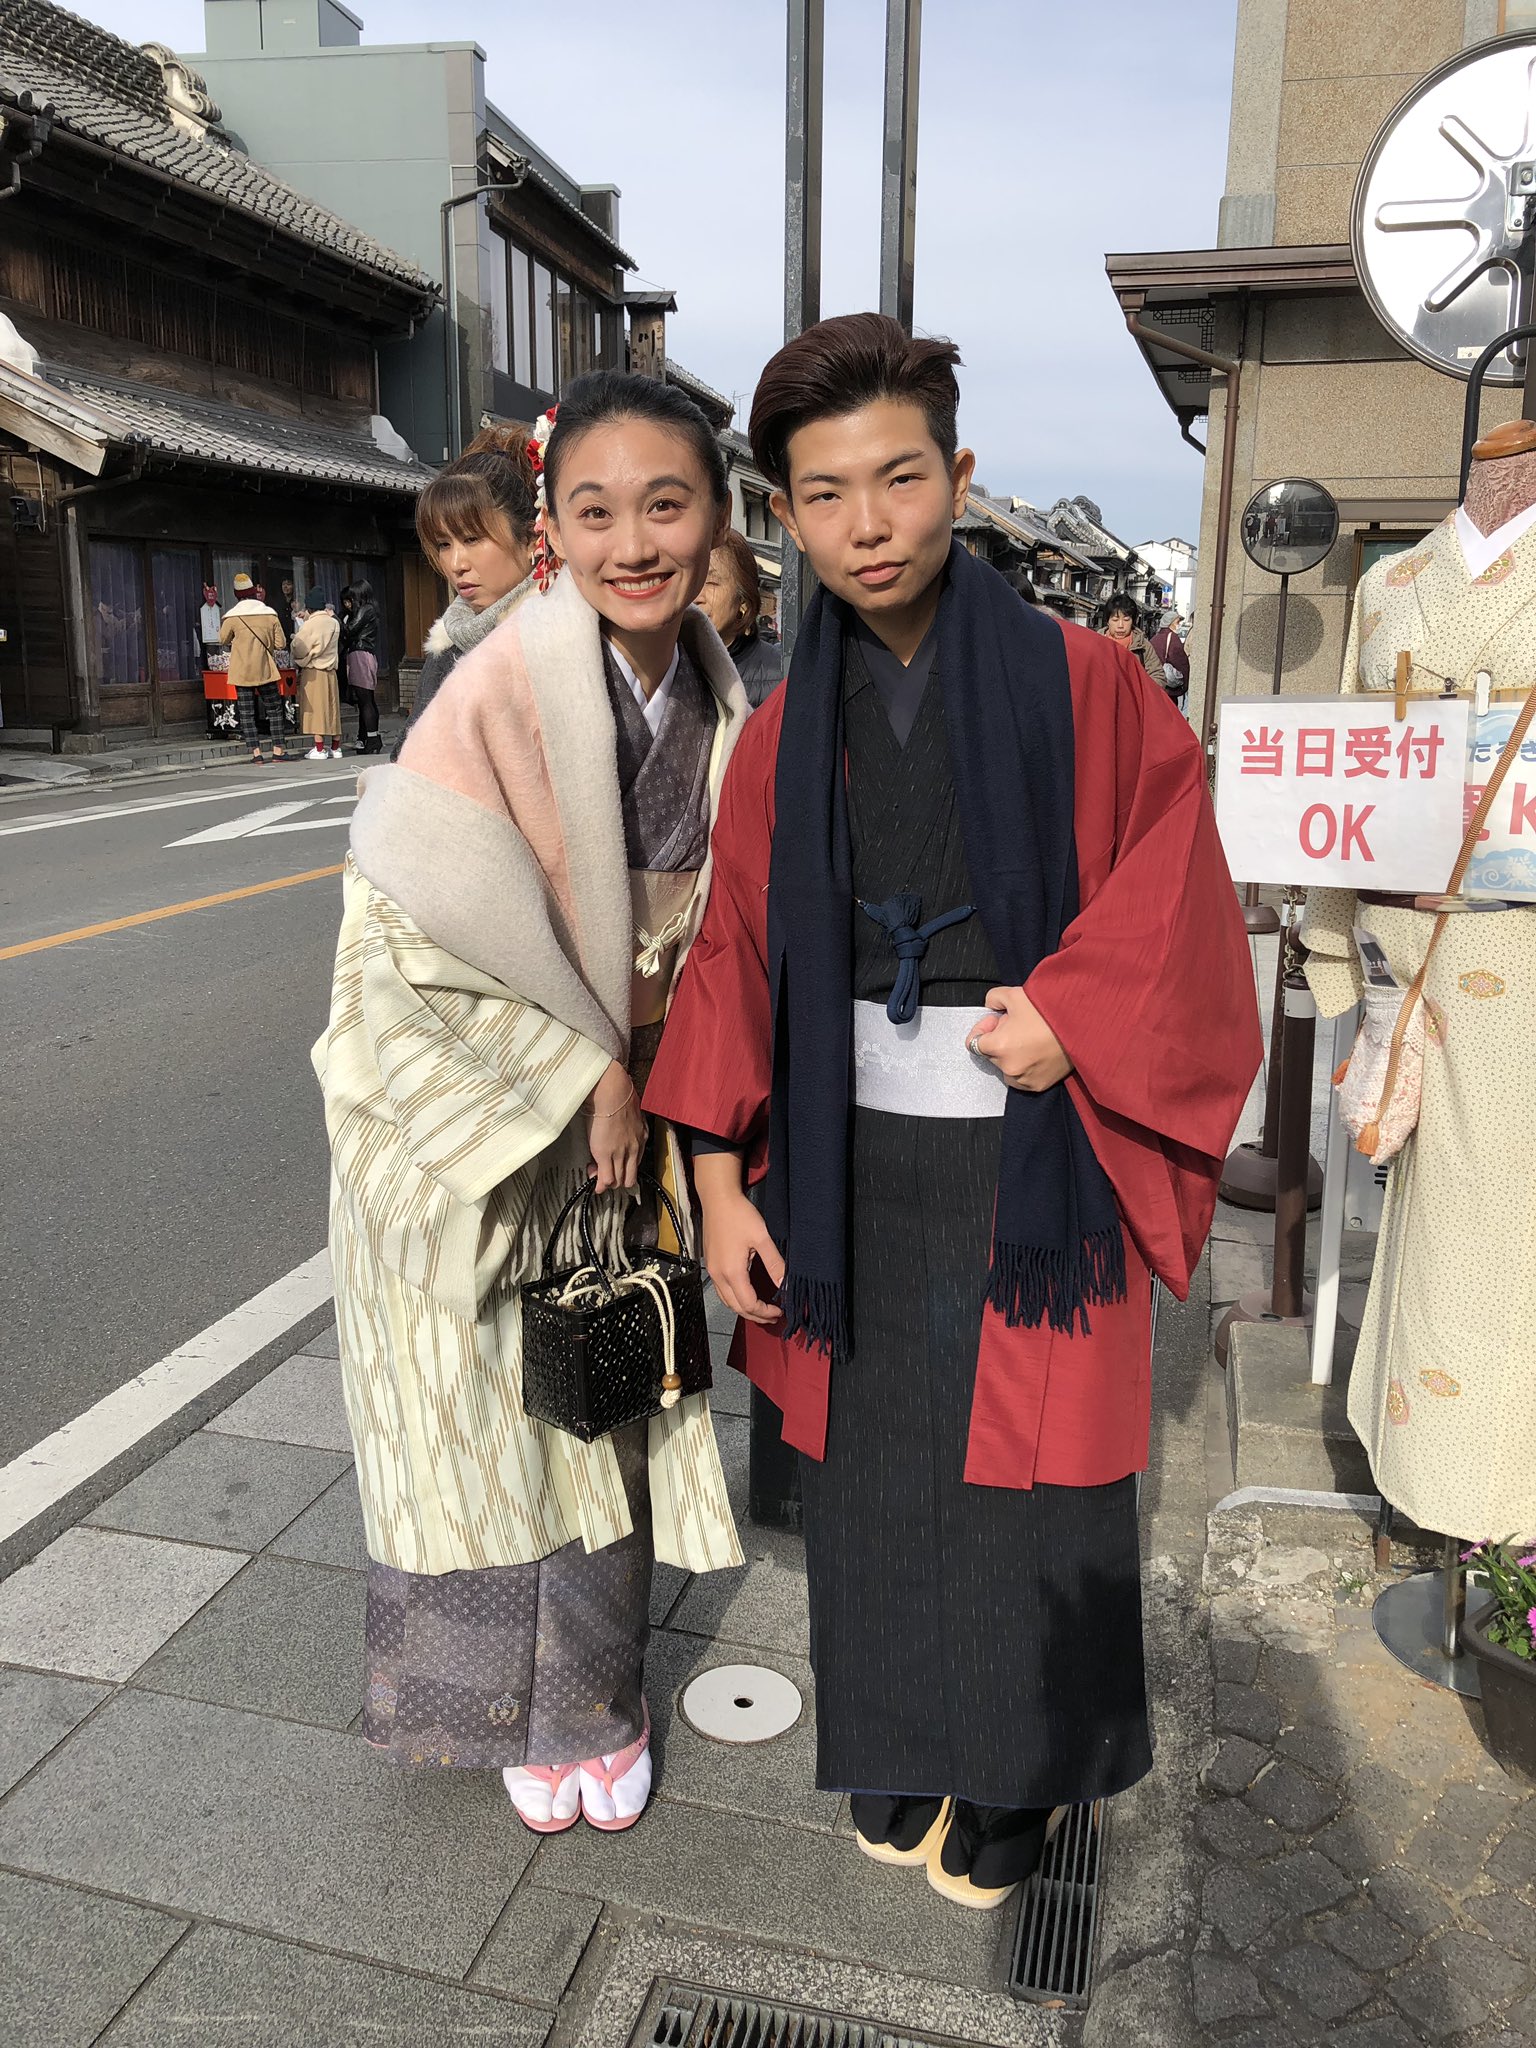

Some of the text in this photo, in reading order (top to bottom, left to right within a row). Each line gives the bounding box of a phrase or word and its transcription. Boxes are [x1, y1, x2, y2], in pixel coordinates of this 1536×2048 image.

[1240, 724, 1445, 779] 当日受付
[1299, 803, 1376, 862] OK
